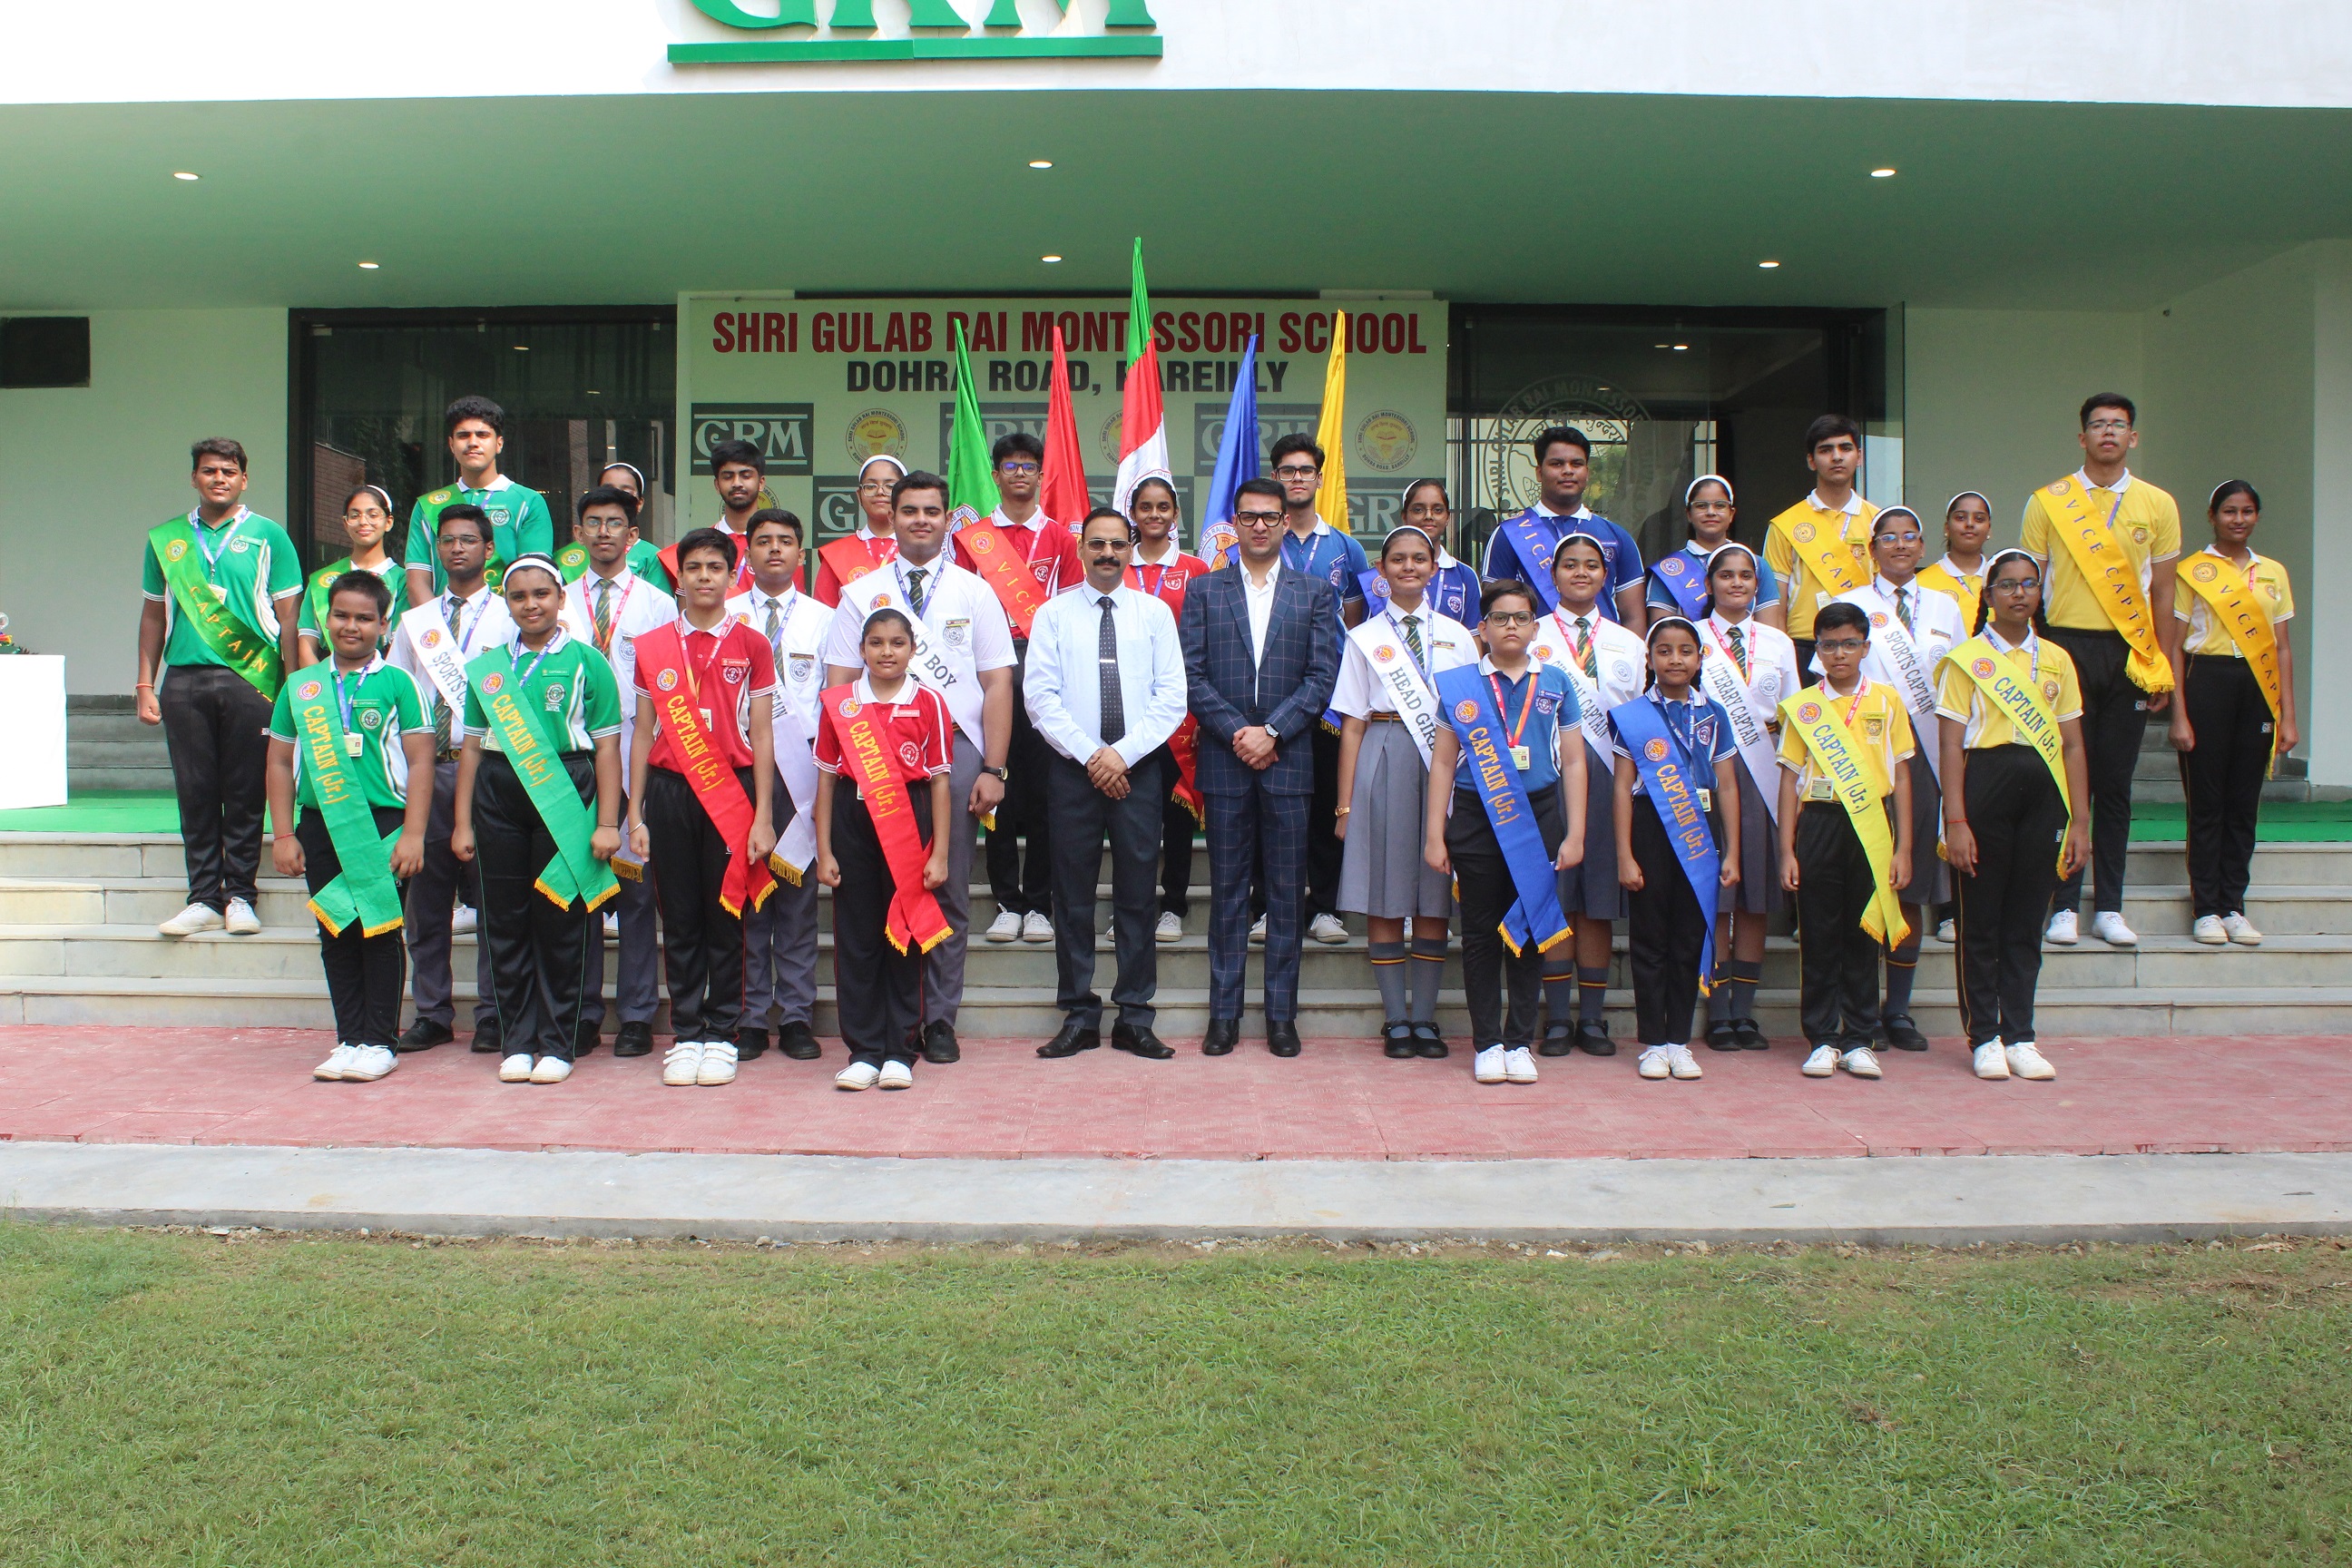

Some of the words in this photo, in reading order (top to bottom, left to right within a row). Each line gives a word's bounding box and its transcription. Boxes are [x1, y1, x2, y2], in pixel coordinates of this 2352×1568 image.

[712, 311, 799, 353] SHRI
[811, 311, 933, 353] GULAB
[1022, 311, 1265, 353] MONTSSORI
[2065, 499, 2104, 554] VICE
[189, 585, 270, 673] CAPTAIN
[2220, 584, 2259, 640] VICE
[433, 651, 468, 692] SPORTS
[924, 653, 957, 690] BOY
[1884, 630, 1916, 671] SPORTS
[1905, 668, 1935, 715] CAPTAIN
[302, 705, 338, 769] CAPTAIN
[1388, 666, 1422, 710] HEAD
[1416, 711, 1437, 751] GIR
[1707, 662, 1743, 707] LITERARY
[1730, 703, 1760, 748] CAPTAIN
[1994, 676, 2047, 733] CAPTAIN
[2036, 729, 2060, 762] (Jr.)
[492, 693, 538, 756] CAPTAIN
[519, 752, 554, 788] (Jr.)
[666, 694, 710, 760] CAPTAIN
[690, 757, 726, 792] (Jr.)
[849, 720, 890, 783] CAPTAIN
[1468, 726, 1510, 792] CAPTAIN
[1813, 724, 1860, 783] CAPTAIN
[1842, 780, 1871, 815] (Jr.)
[316, 771, 350, 805] (Jr.)
[868, 783, 901, 818] (Jr.)
[1486, 791, 1521, 826] (Jr.)
[1656, 763, 1698, 829] CAPTAIN
[1678, 826, 1709, 861] (Jr.)
